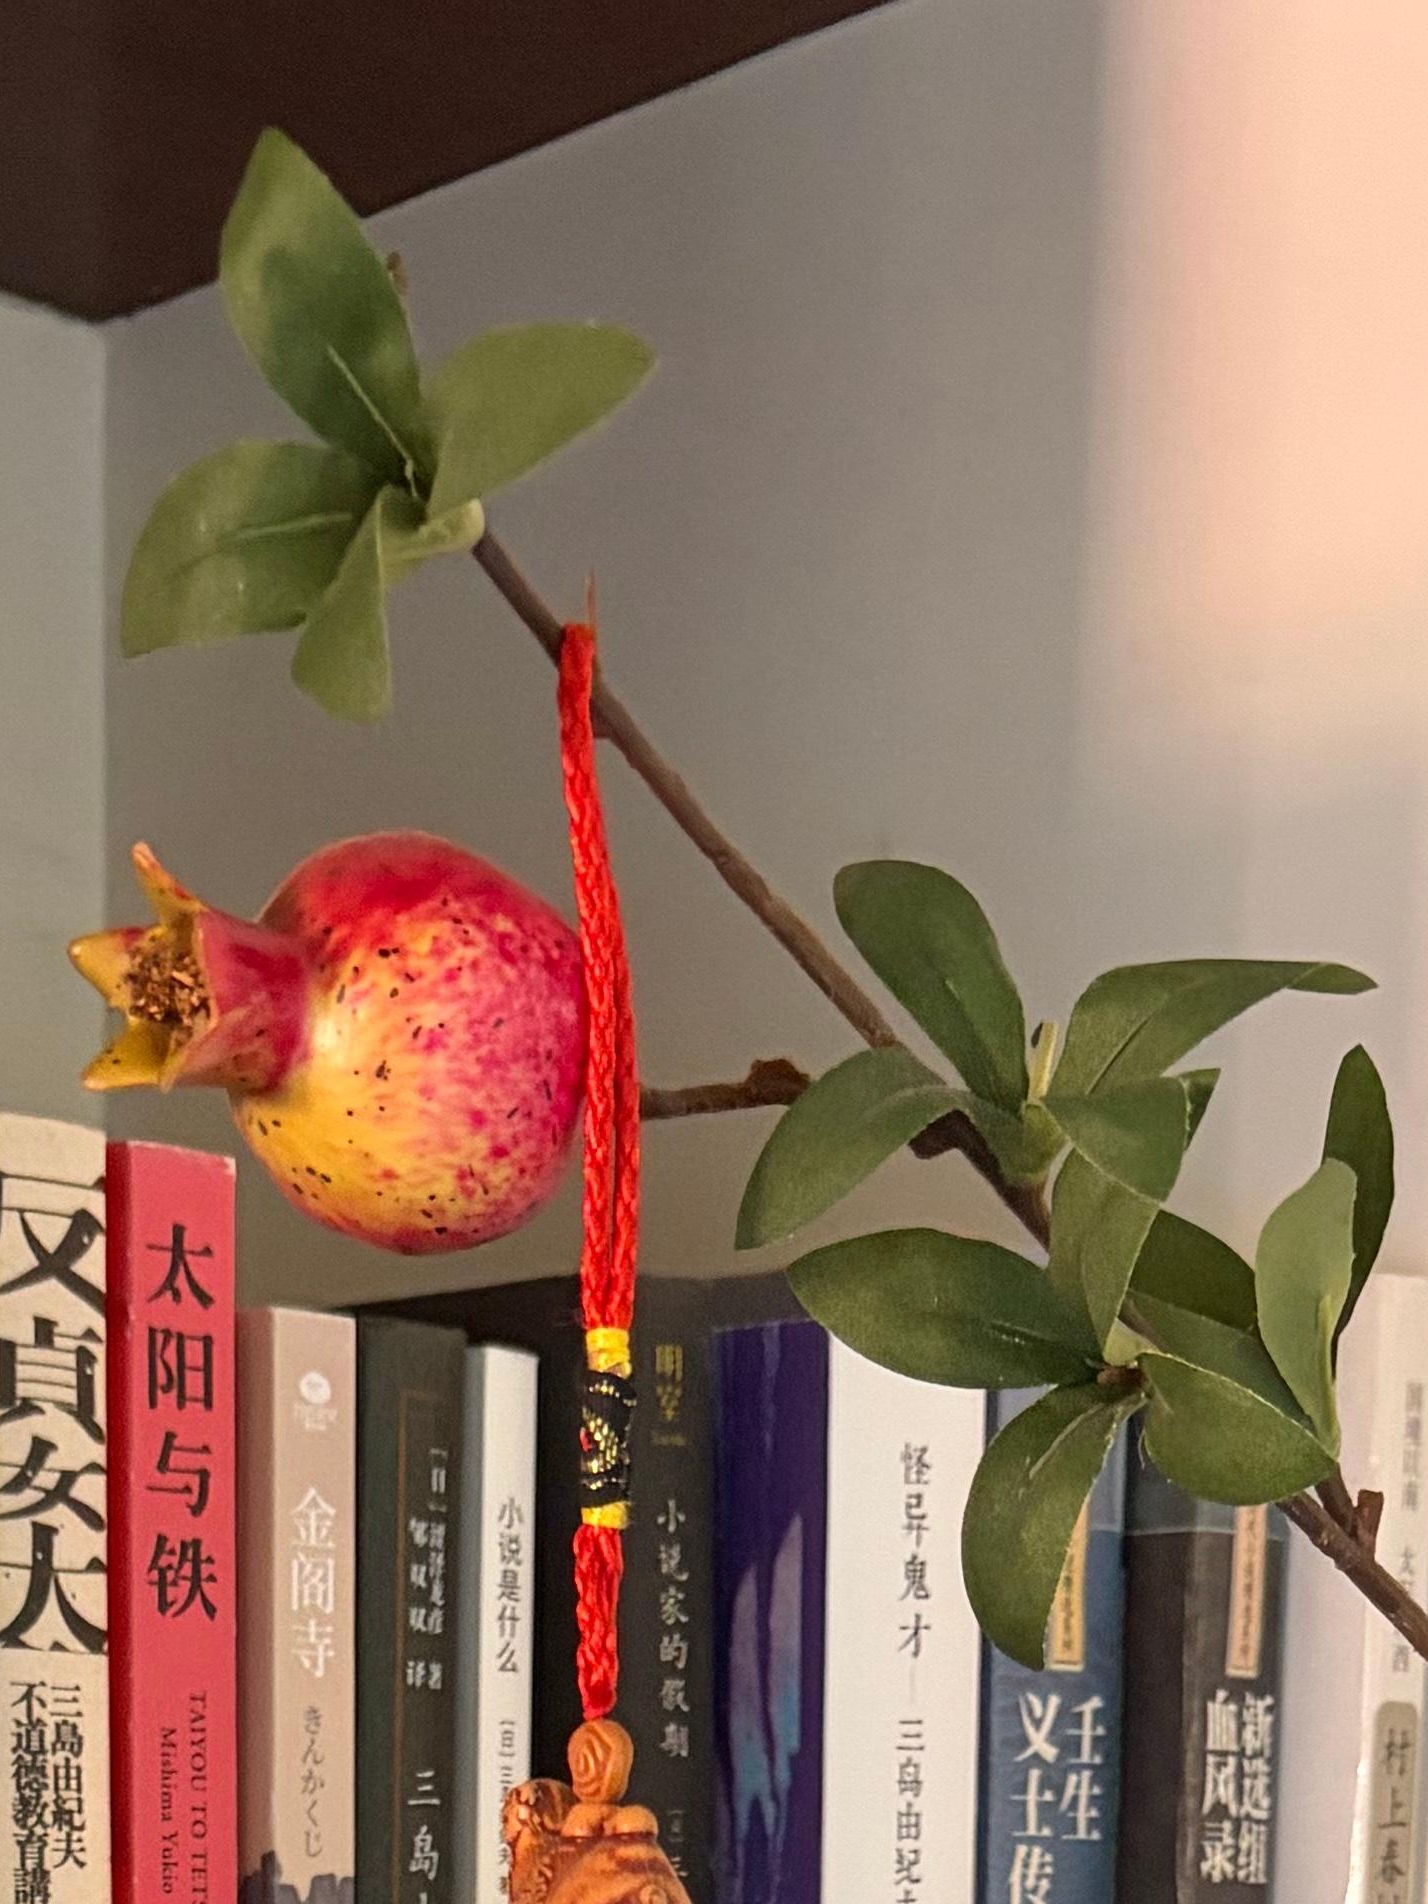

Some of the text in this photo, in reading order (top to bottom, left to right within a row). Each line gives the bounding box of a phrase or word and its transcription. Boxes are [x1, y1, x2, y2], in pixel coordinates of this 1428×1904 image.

[146, 1223, 217, 1621] 太阳与铁
[290, 1487, 336, 1679] 金阁寺
[495, 1498, 524, 1675] 小说是什么
[49, 1685, 87, 1869] 三島由紀夫
[160, 1727, 177, 1822] Mishima
[188, 1691, 208, 1796] TAIYOU
[303, 1705, 327, 1859] きんかくじ
[1060, 1696, 1106, 1841] 壬生
[1200, 1689, 1239, 1884] 血风录
[1238, 1694, 1274, 1884] 新选组
